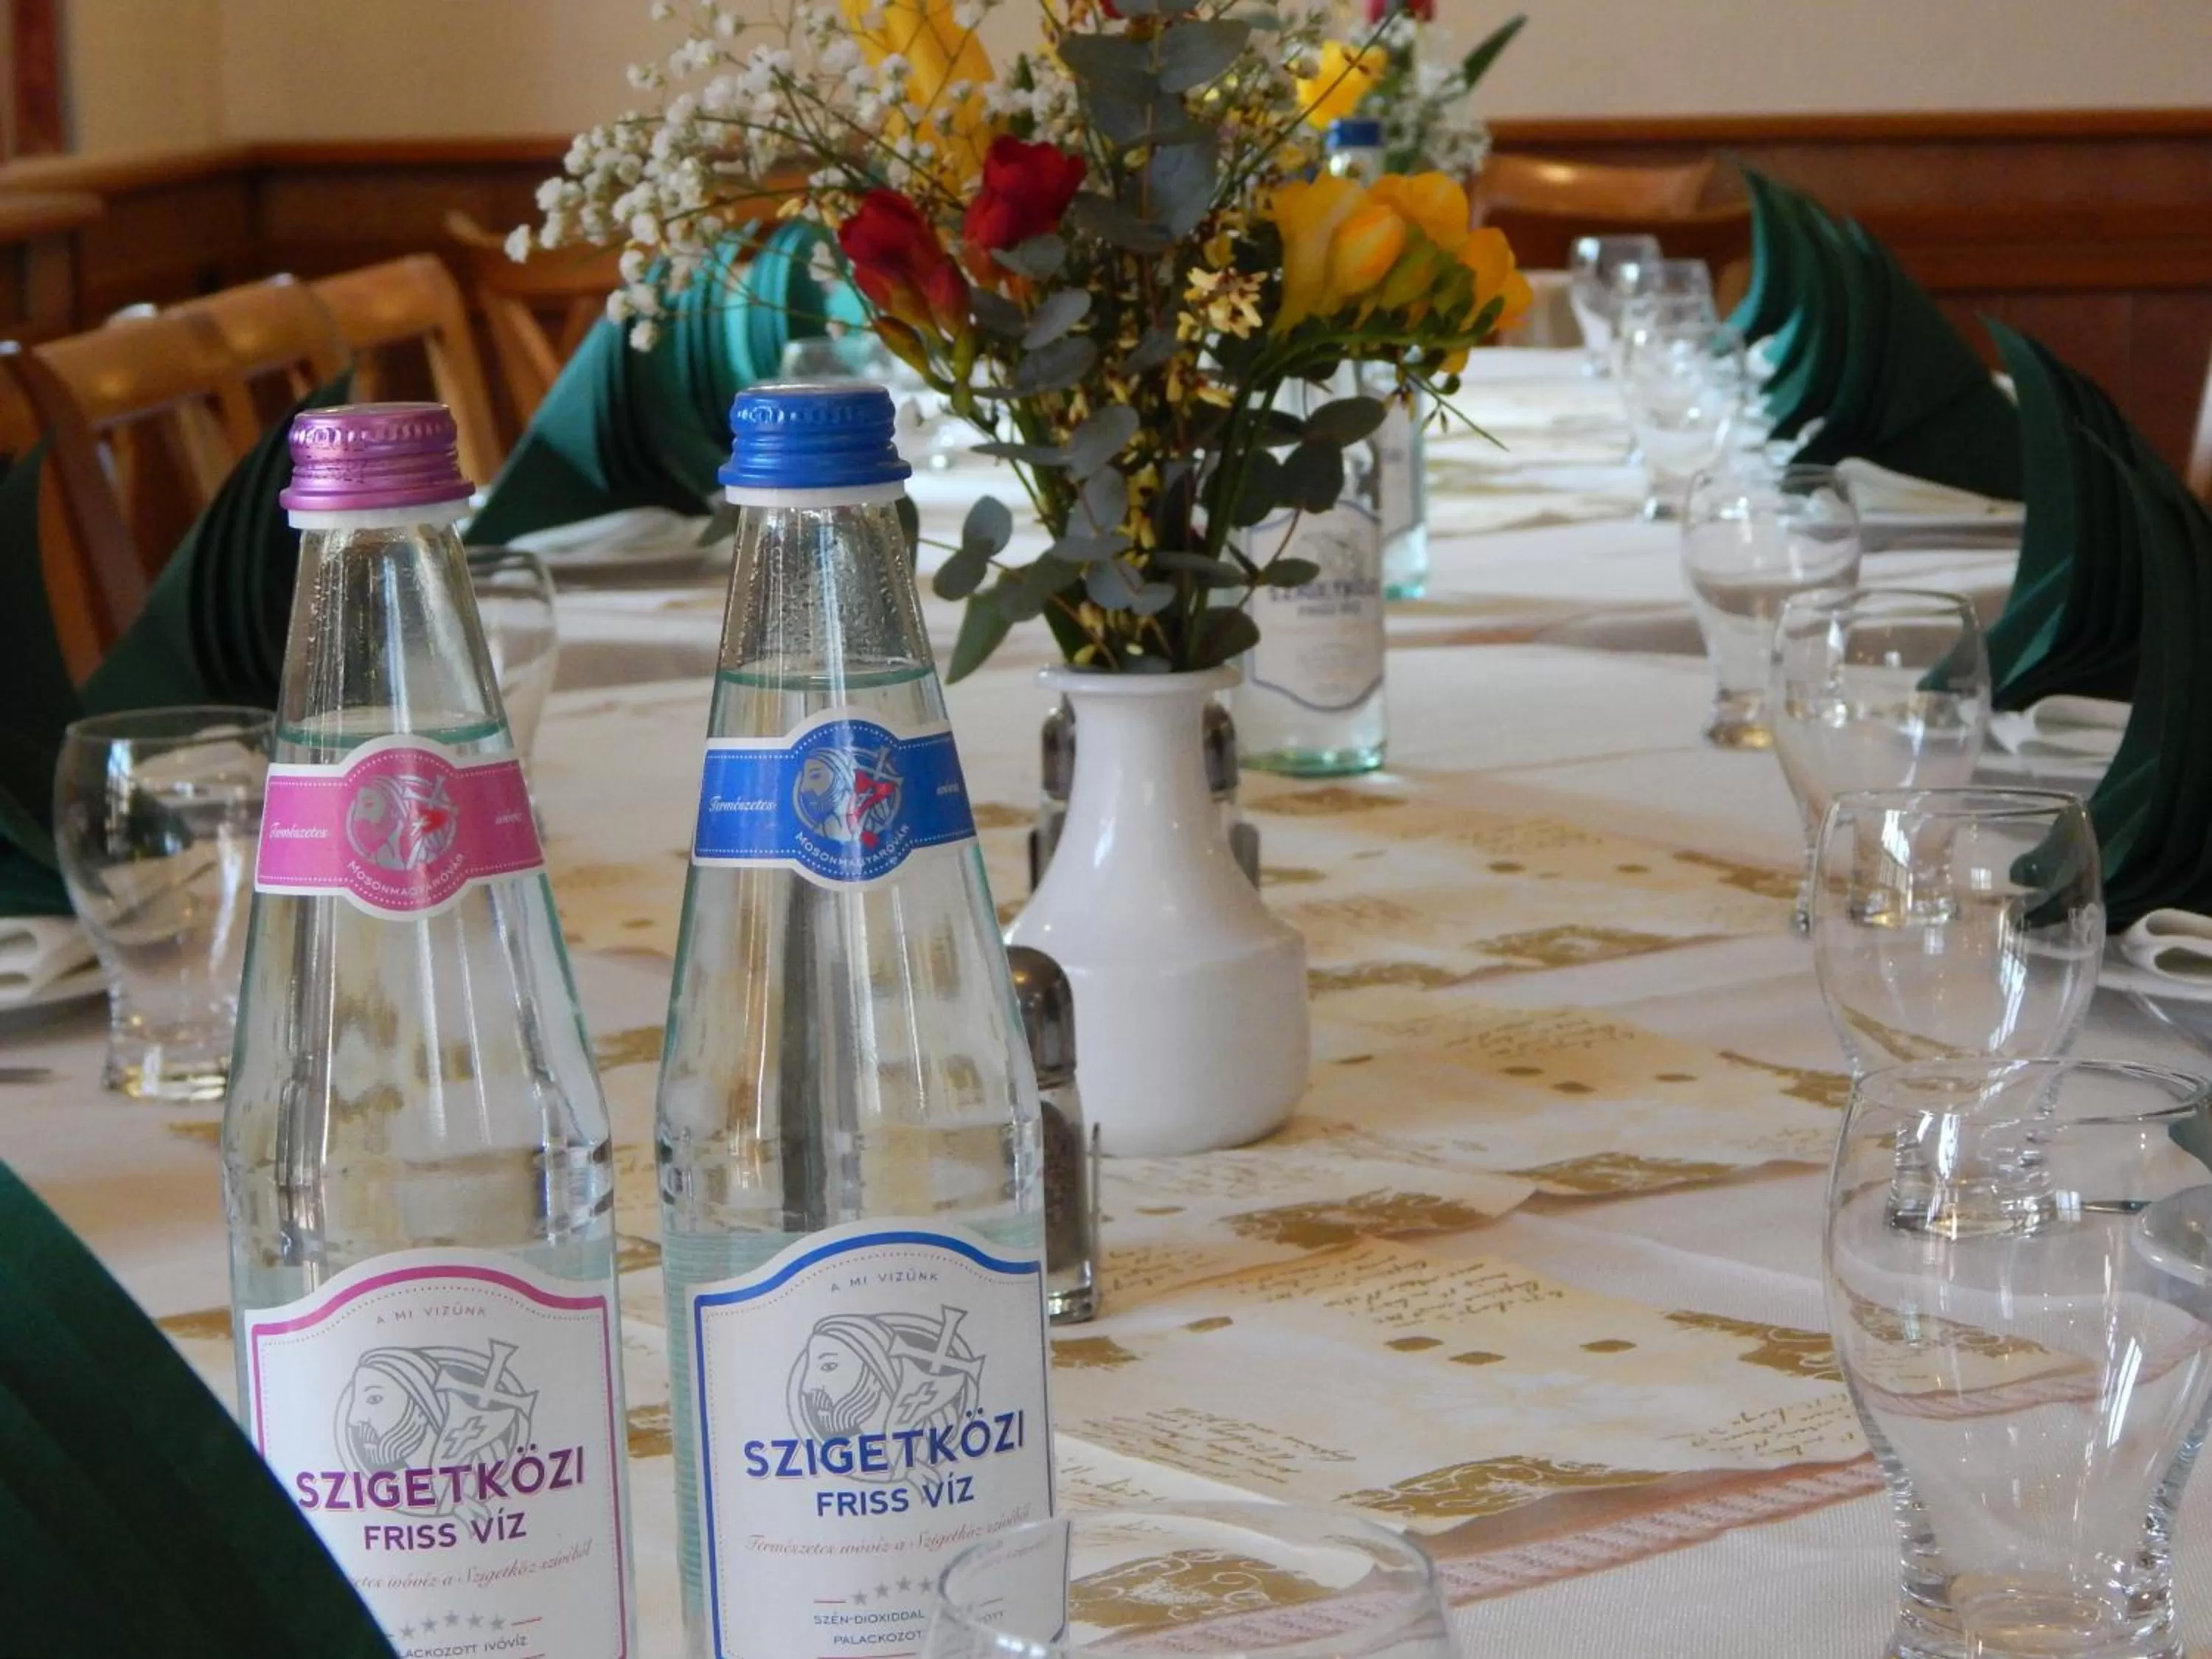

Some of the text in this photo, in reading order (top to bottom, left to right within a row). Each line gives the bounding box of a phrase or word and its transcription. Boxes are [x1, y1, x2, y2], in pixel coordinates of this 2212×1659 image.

[849, 1276, 867, 1287] MI
[743, 1408, 1026, 1479] SZIGETKÖZI
[295, 1443, 586, 1511] SZIGETKÖZI
[816, 1475, 975, 1517] FRISS VÍZ
[364, 1507, 528, 1551] FRISS VÍZ
[833, 1630, 923, 1645] PALACKOZOT
